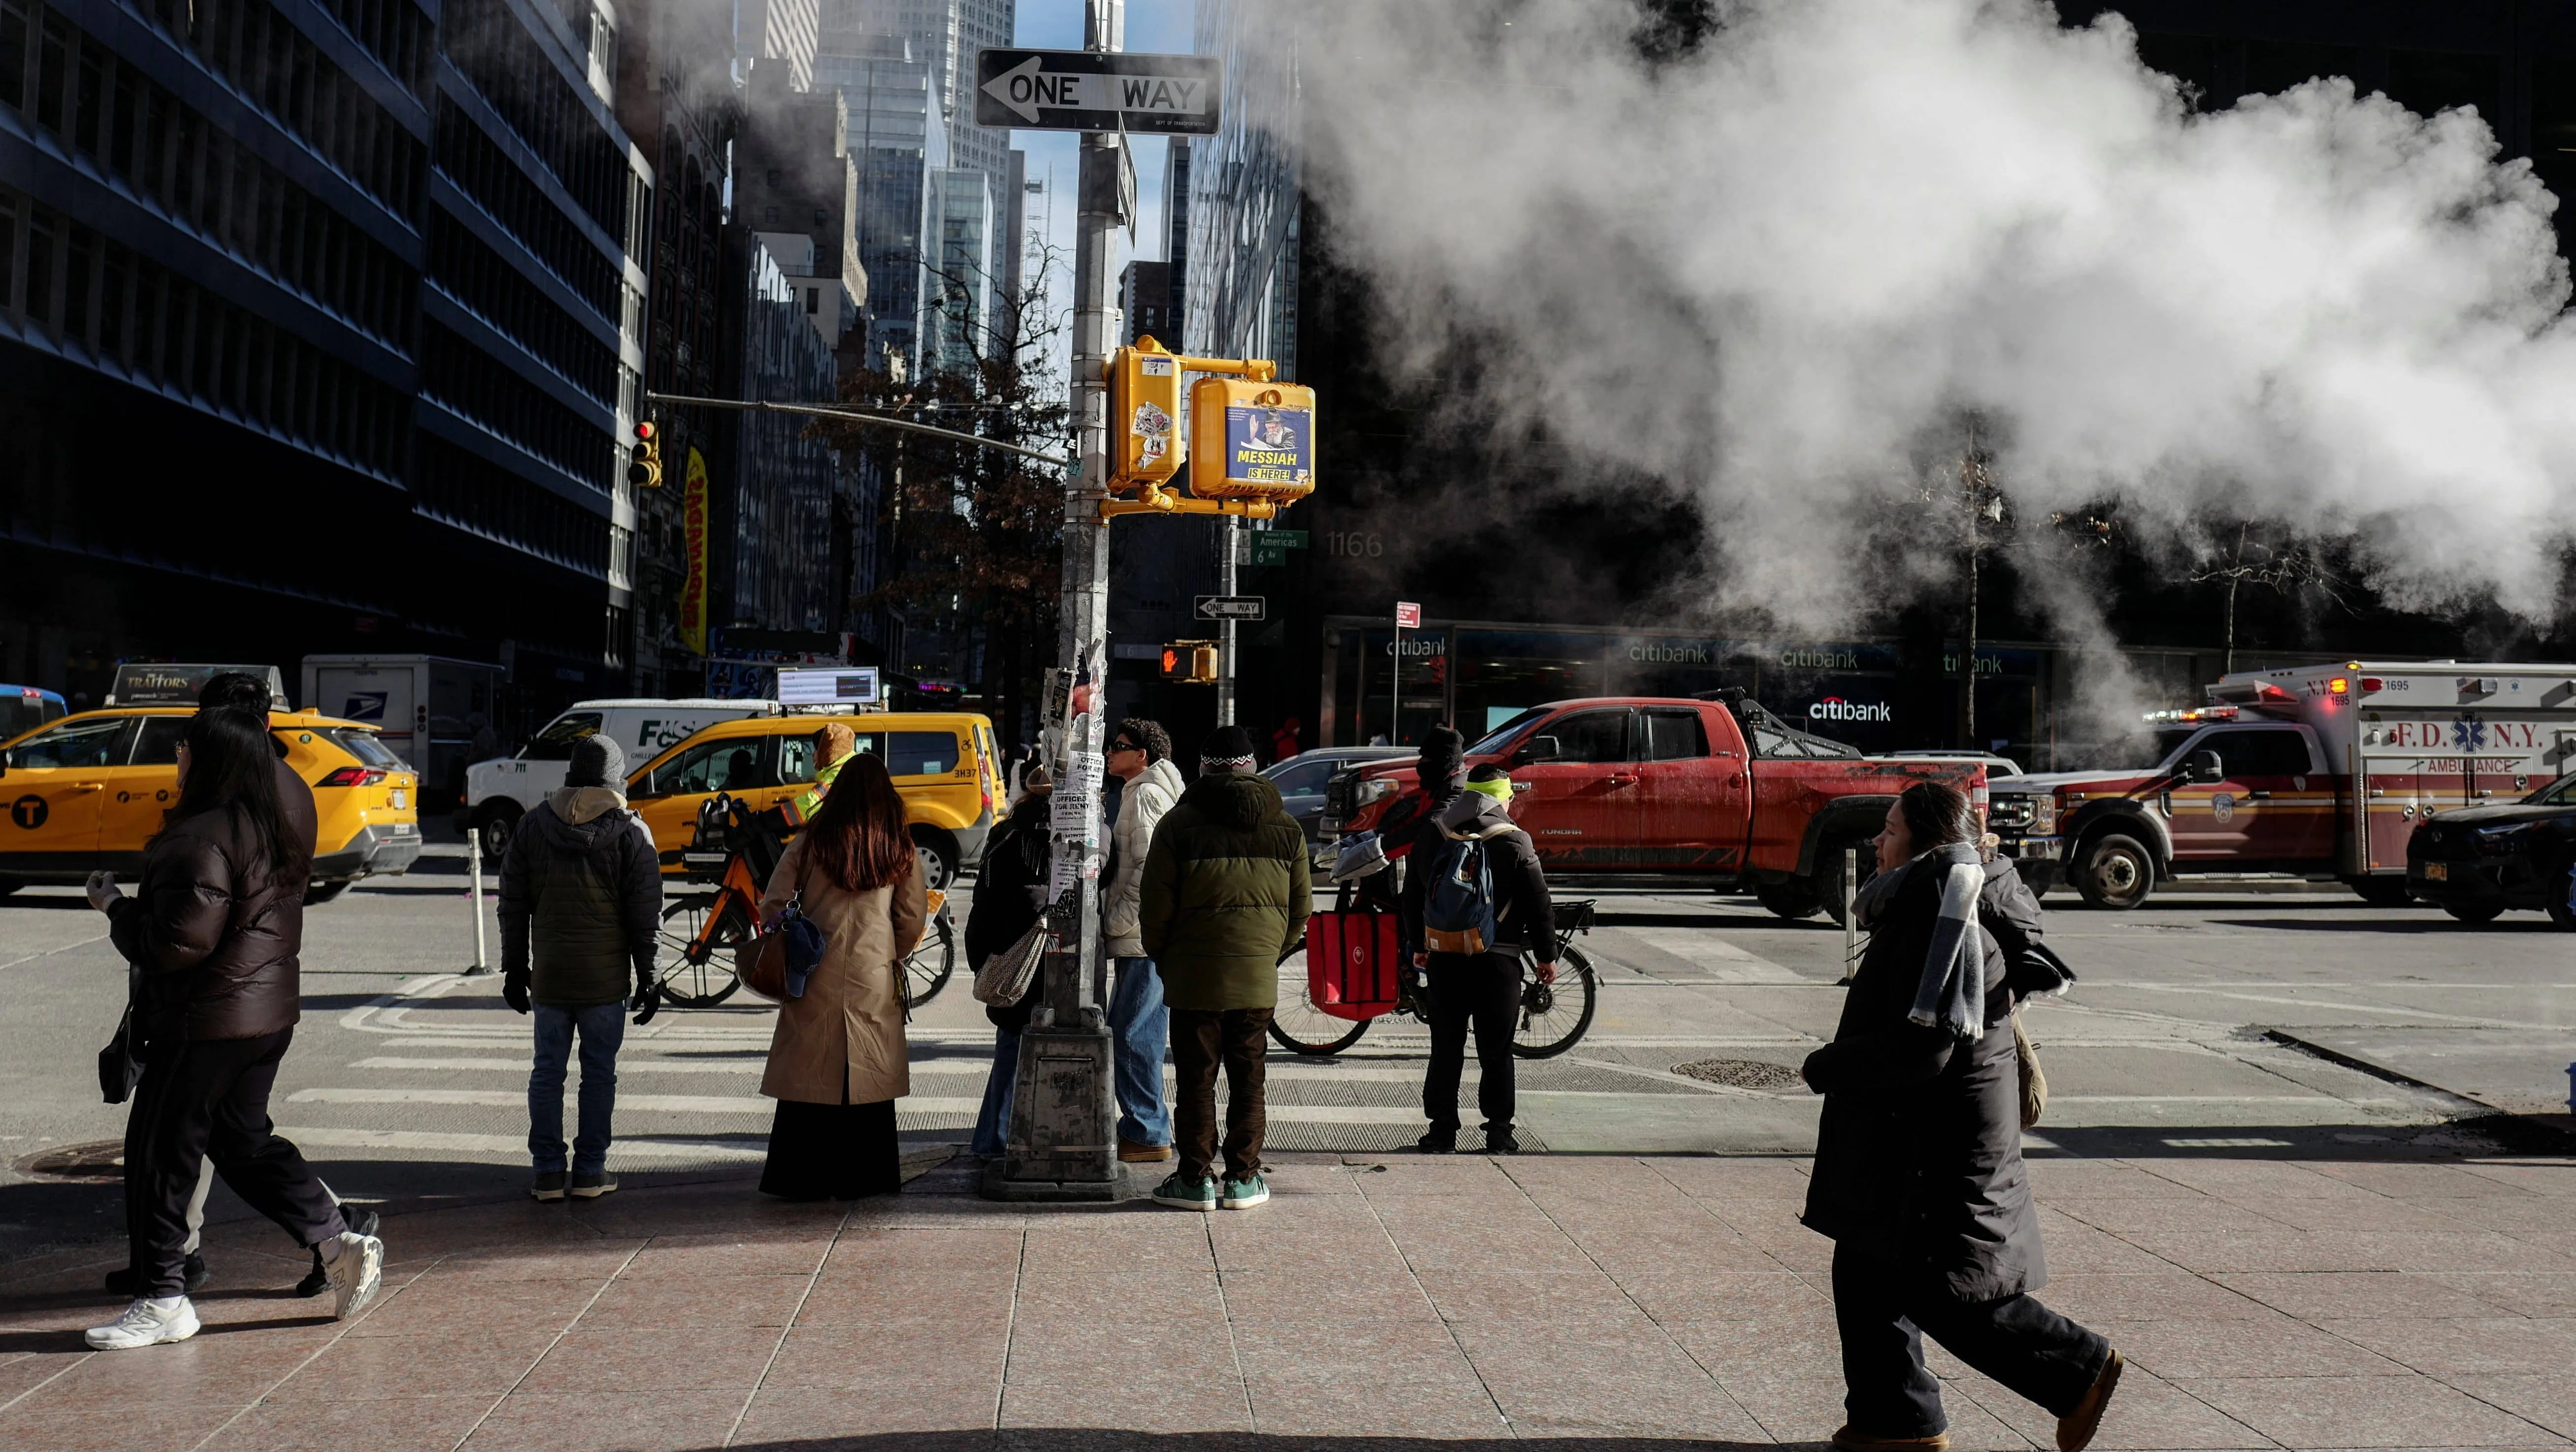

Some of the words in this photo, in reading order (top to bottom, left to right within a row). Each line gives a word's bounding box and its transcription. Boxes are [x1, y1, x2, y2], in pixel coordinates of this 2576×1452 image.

[1009, 74, 1080, 105] ONE
[1123, 79, 1197, 109] WAY
[1237, 450, 1296, 466] MESSIAH
[1249, 469, 1257, 477] IS
[1260, 470, 1289, 479] HERE!
[1260, 538, 1297, 547] Americas
[1326, 530, 1383, 557] 1166
[1258, 551, 1264, 563] 6
[1207, 604, 1225, 612] ONE
[1237, 604, 1256, 612] WAY
[1387, 637, 1446, 656] ctibank
[1629, 644, 1708, 663] citibank
[1780, 649, 1857, 669] citibank
[2386, 680, 2409, 690] 1695
[2331, 695, 2349, 706] 1695
[1810, 700, 1890, 722] citibank
[2397, 722, 2447, 747] F.D.
[2494, 724, 2543, 748] N.Y.
[515, 763, 526, 773] 711
[1081, 757, 1103, 766] OFFICE
[2428, 759, 2512, 773] AMBULANCE
[955, 769, 976, 778] 3H37
[20, 801, 40, 825] T
